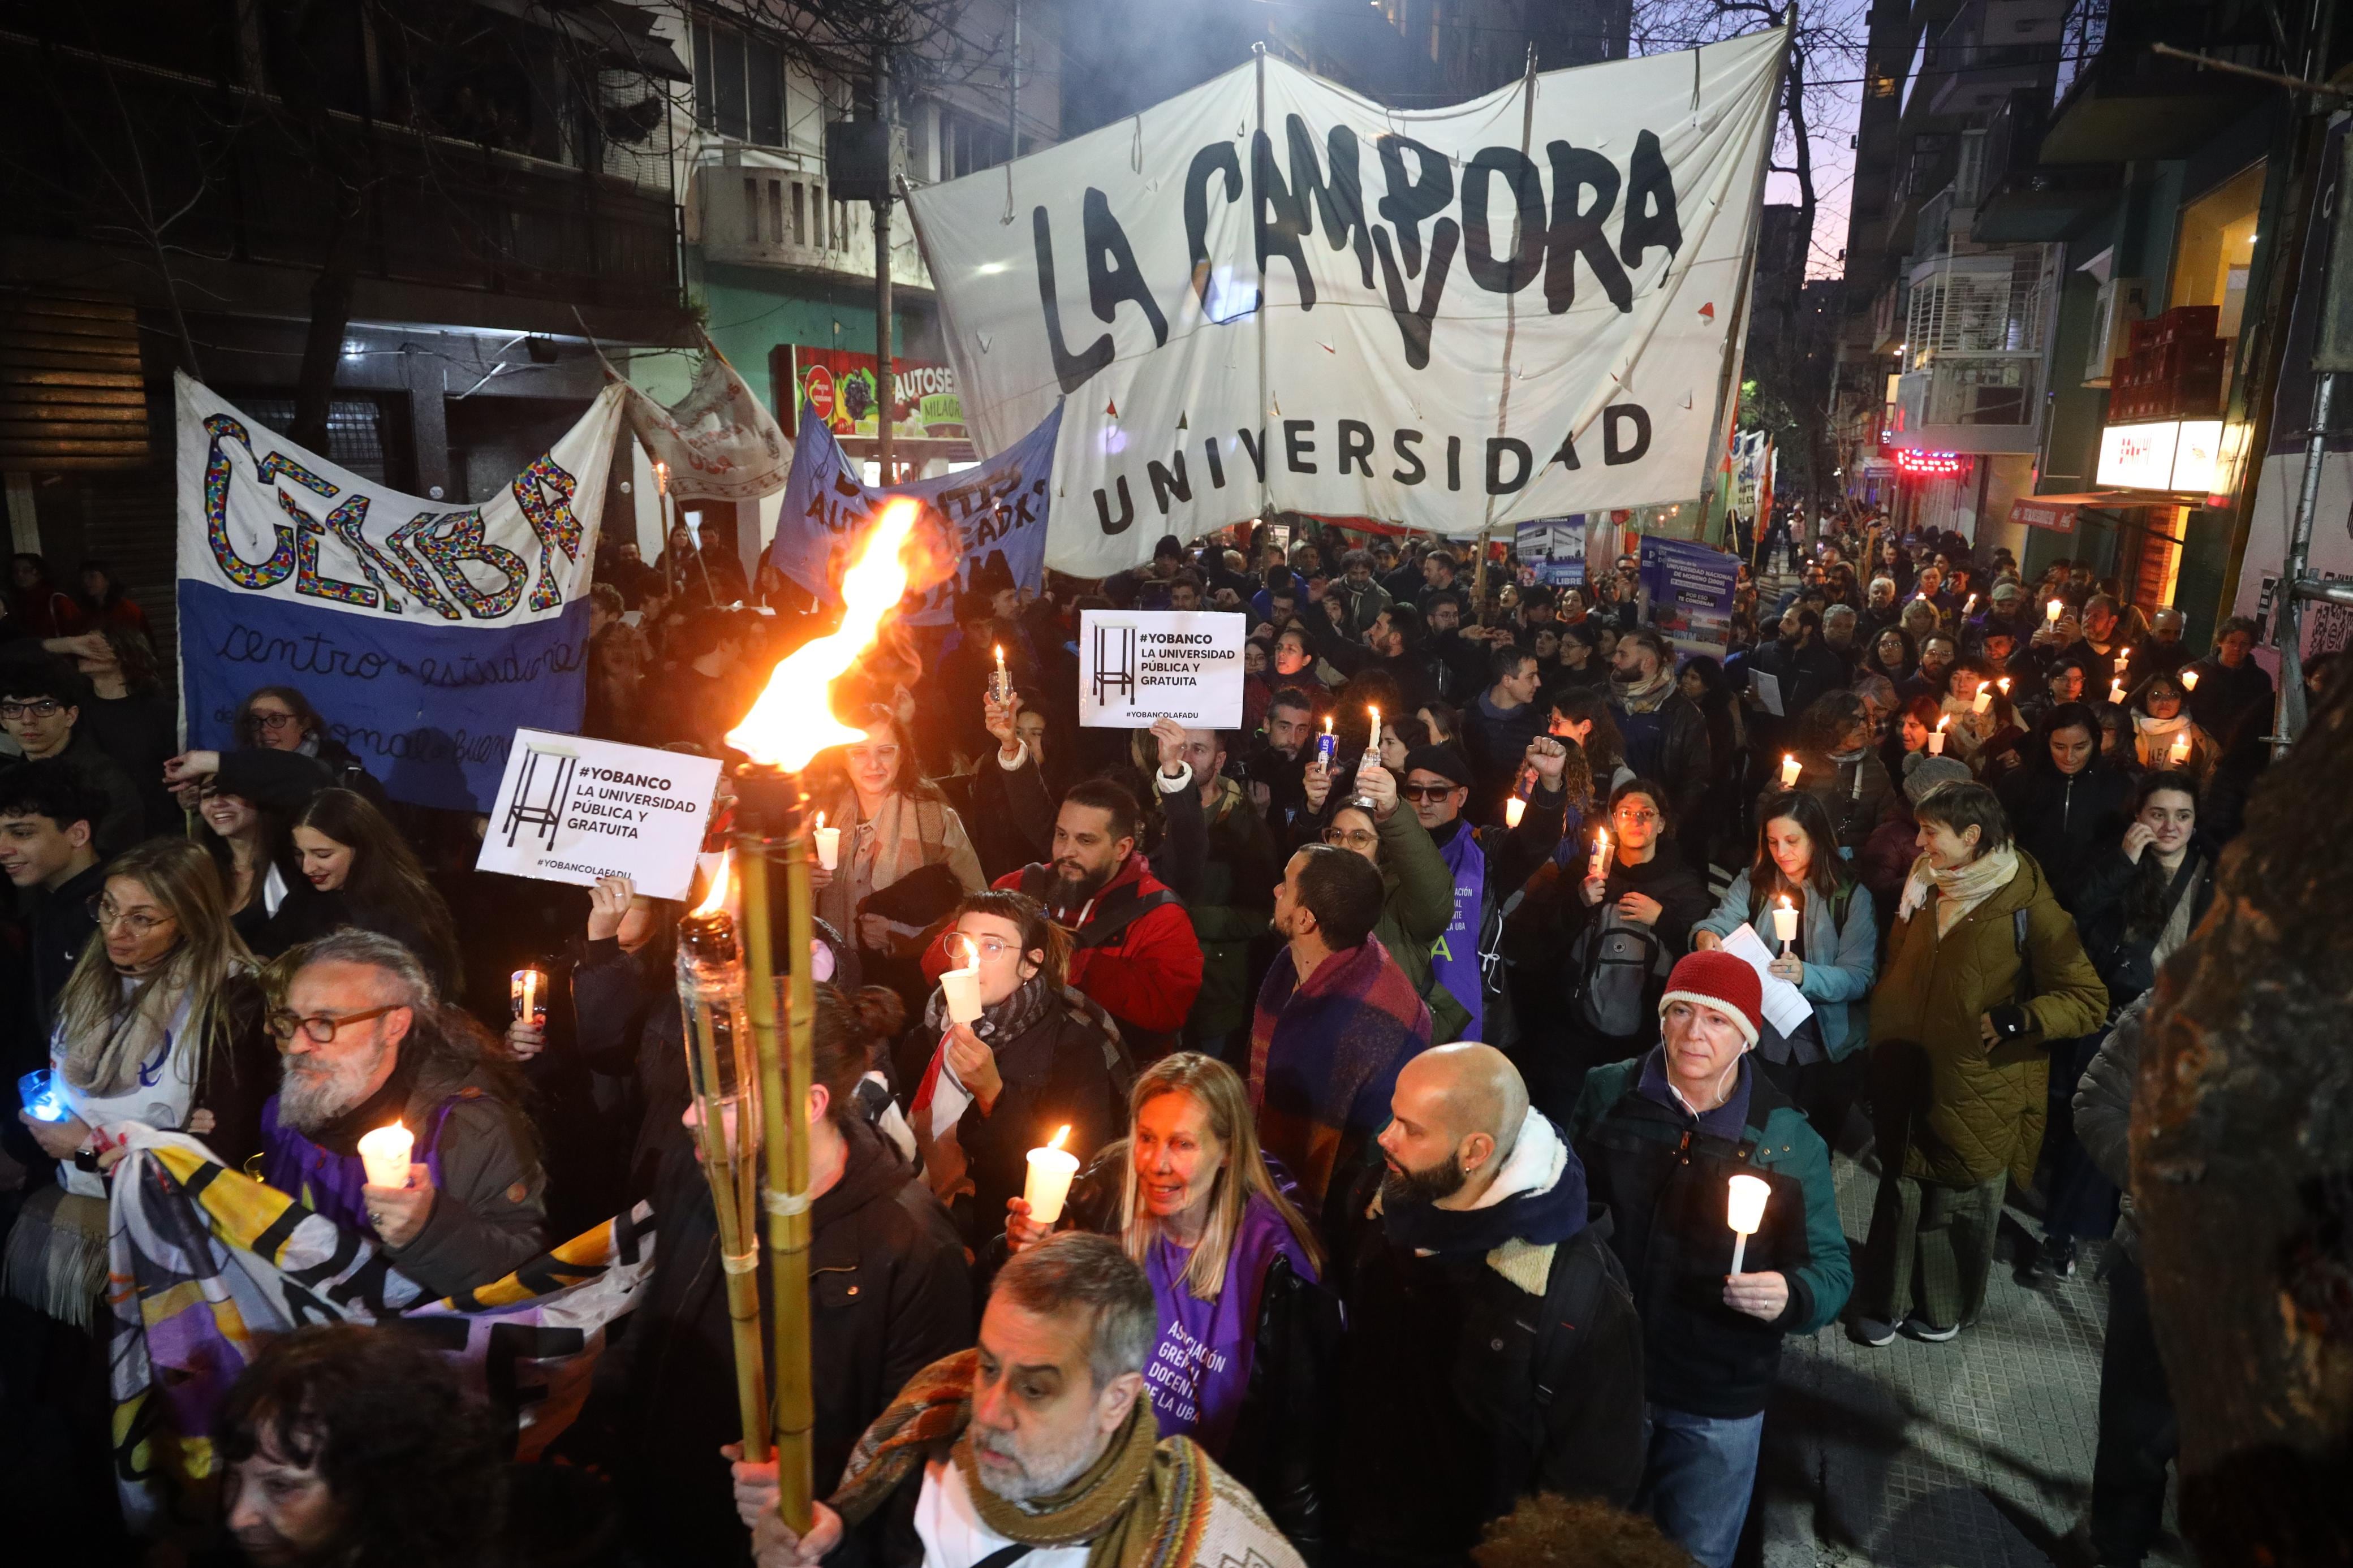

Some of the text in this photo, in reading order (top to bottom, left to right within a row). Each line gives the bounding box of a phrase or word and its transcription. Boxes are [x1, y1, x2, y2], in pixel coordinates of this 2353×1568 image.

[1033, 186, 1169, 394] LA
[894, 366, 955, 404] AUTOSE
[1092, 403, 1652, 535] UNIVERSIDAD
[1666, 563, 1704, 575] UNIVERSIDAD
[1705, 570, 1734, 581] NACIONAL
[1682, 572, 1707, 582] MORENO
[1685, 598, 1714, 607] CONDENAN
[1140, 633, 1213, 644] #YOBANCO
[1141, 649, 1235, 659] LA UNIVERSIDAD
[1141, 660, 1200, 672] PÚBLICA Y
[1141, 676, 1197, 686] GRATUITA
[579, 766, 671, 791] #YOBANCO
[576, 784, 696, 813] LA UNIVERSIDAD
[572, 800, 649, 823] PÚBLICA Y
[567, 818, 639, 839] GRATUITA
[1455, 922, 1466, 931] UBA
[1157, 1392, 1174, 1412] LA
[1176, 1403, 1200, 1424] UBA
